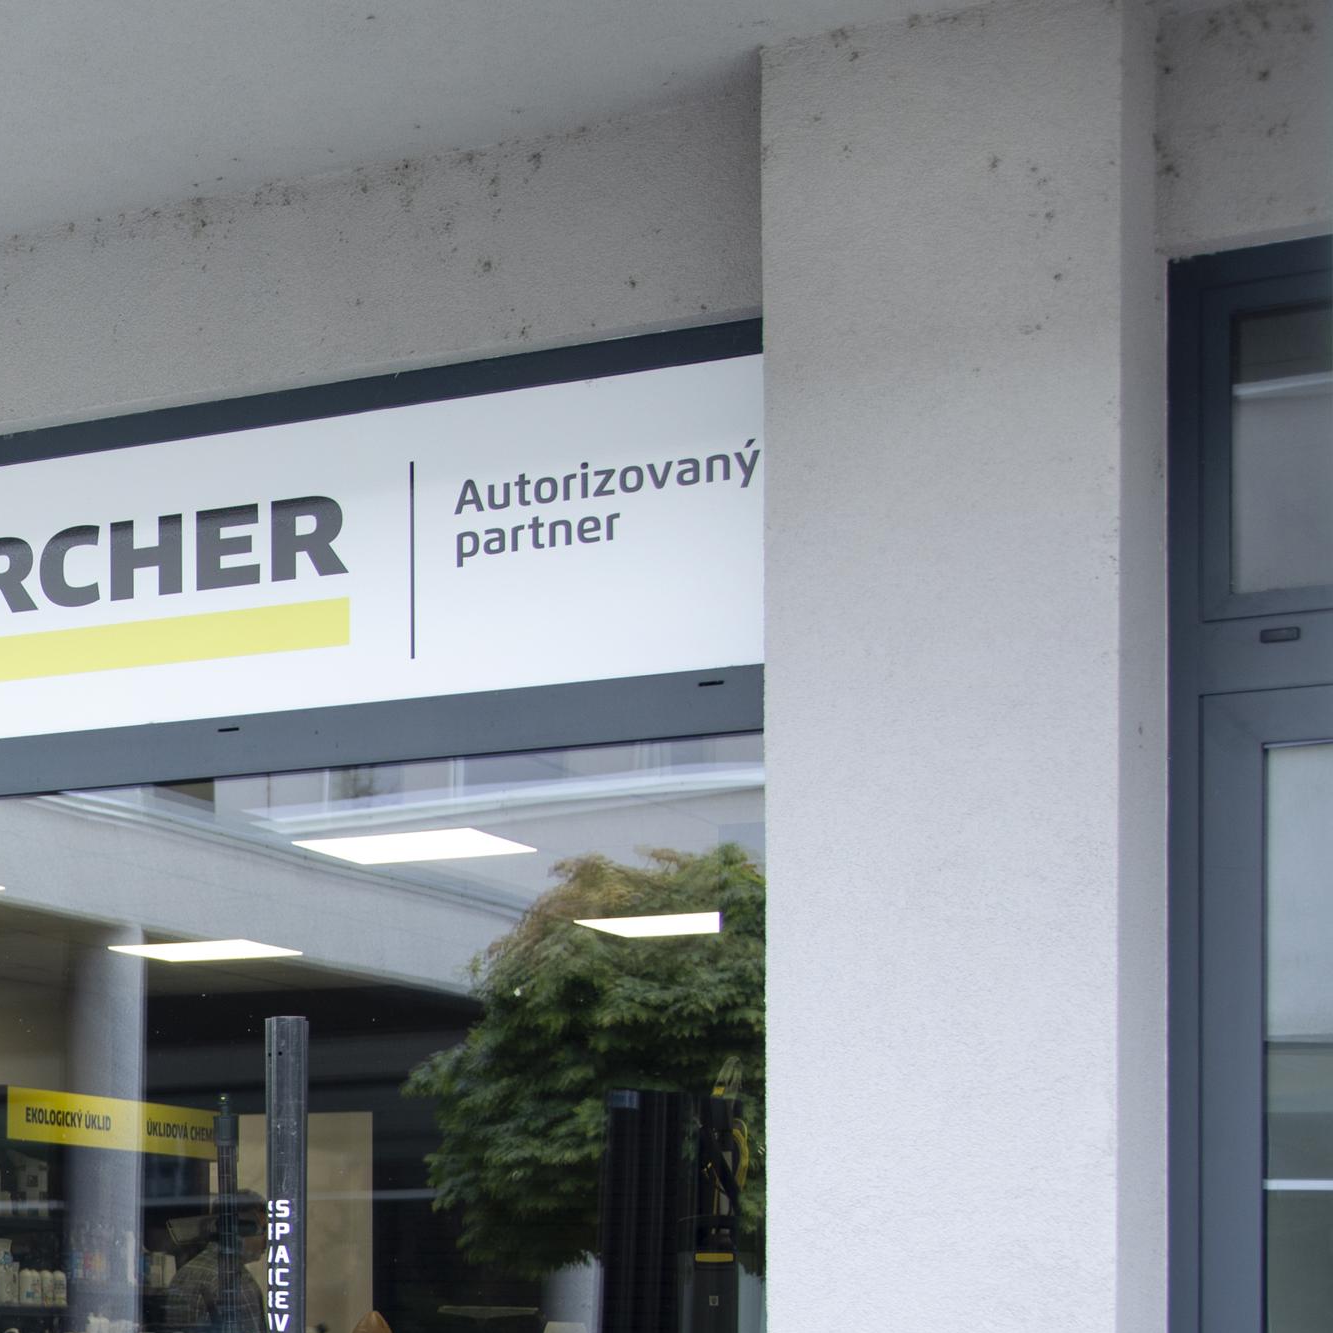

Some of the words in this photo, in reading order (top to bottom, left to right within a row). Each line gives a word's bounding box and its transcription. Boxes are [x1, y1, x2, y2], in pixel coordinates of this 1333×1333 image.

[453, 437, 762, 516] Autorizovaný
[454, 506, 621, 568] partner
[24, 1105, 83, 1130] EKOLOGICKÝ
[84, 1110, 112, 1132] ÚKLID
